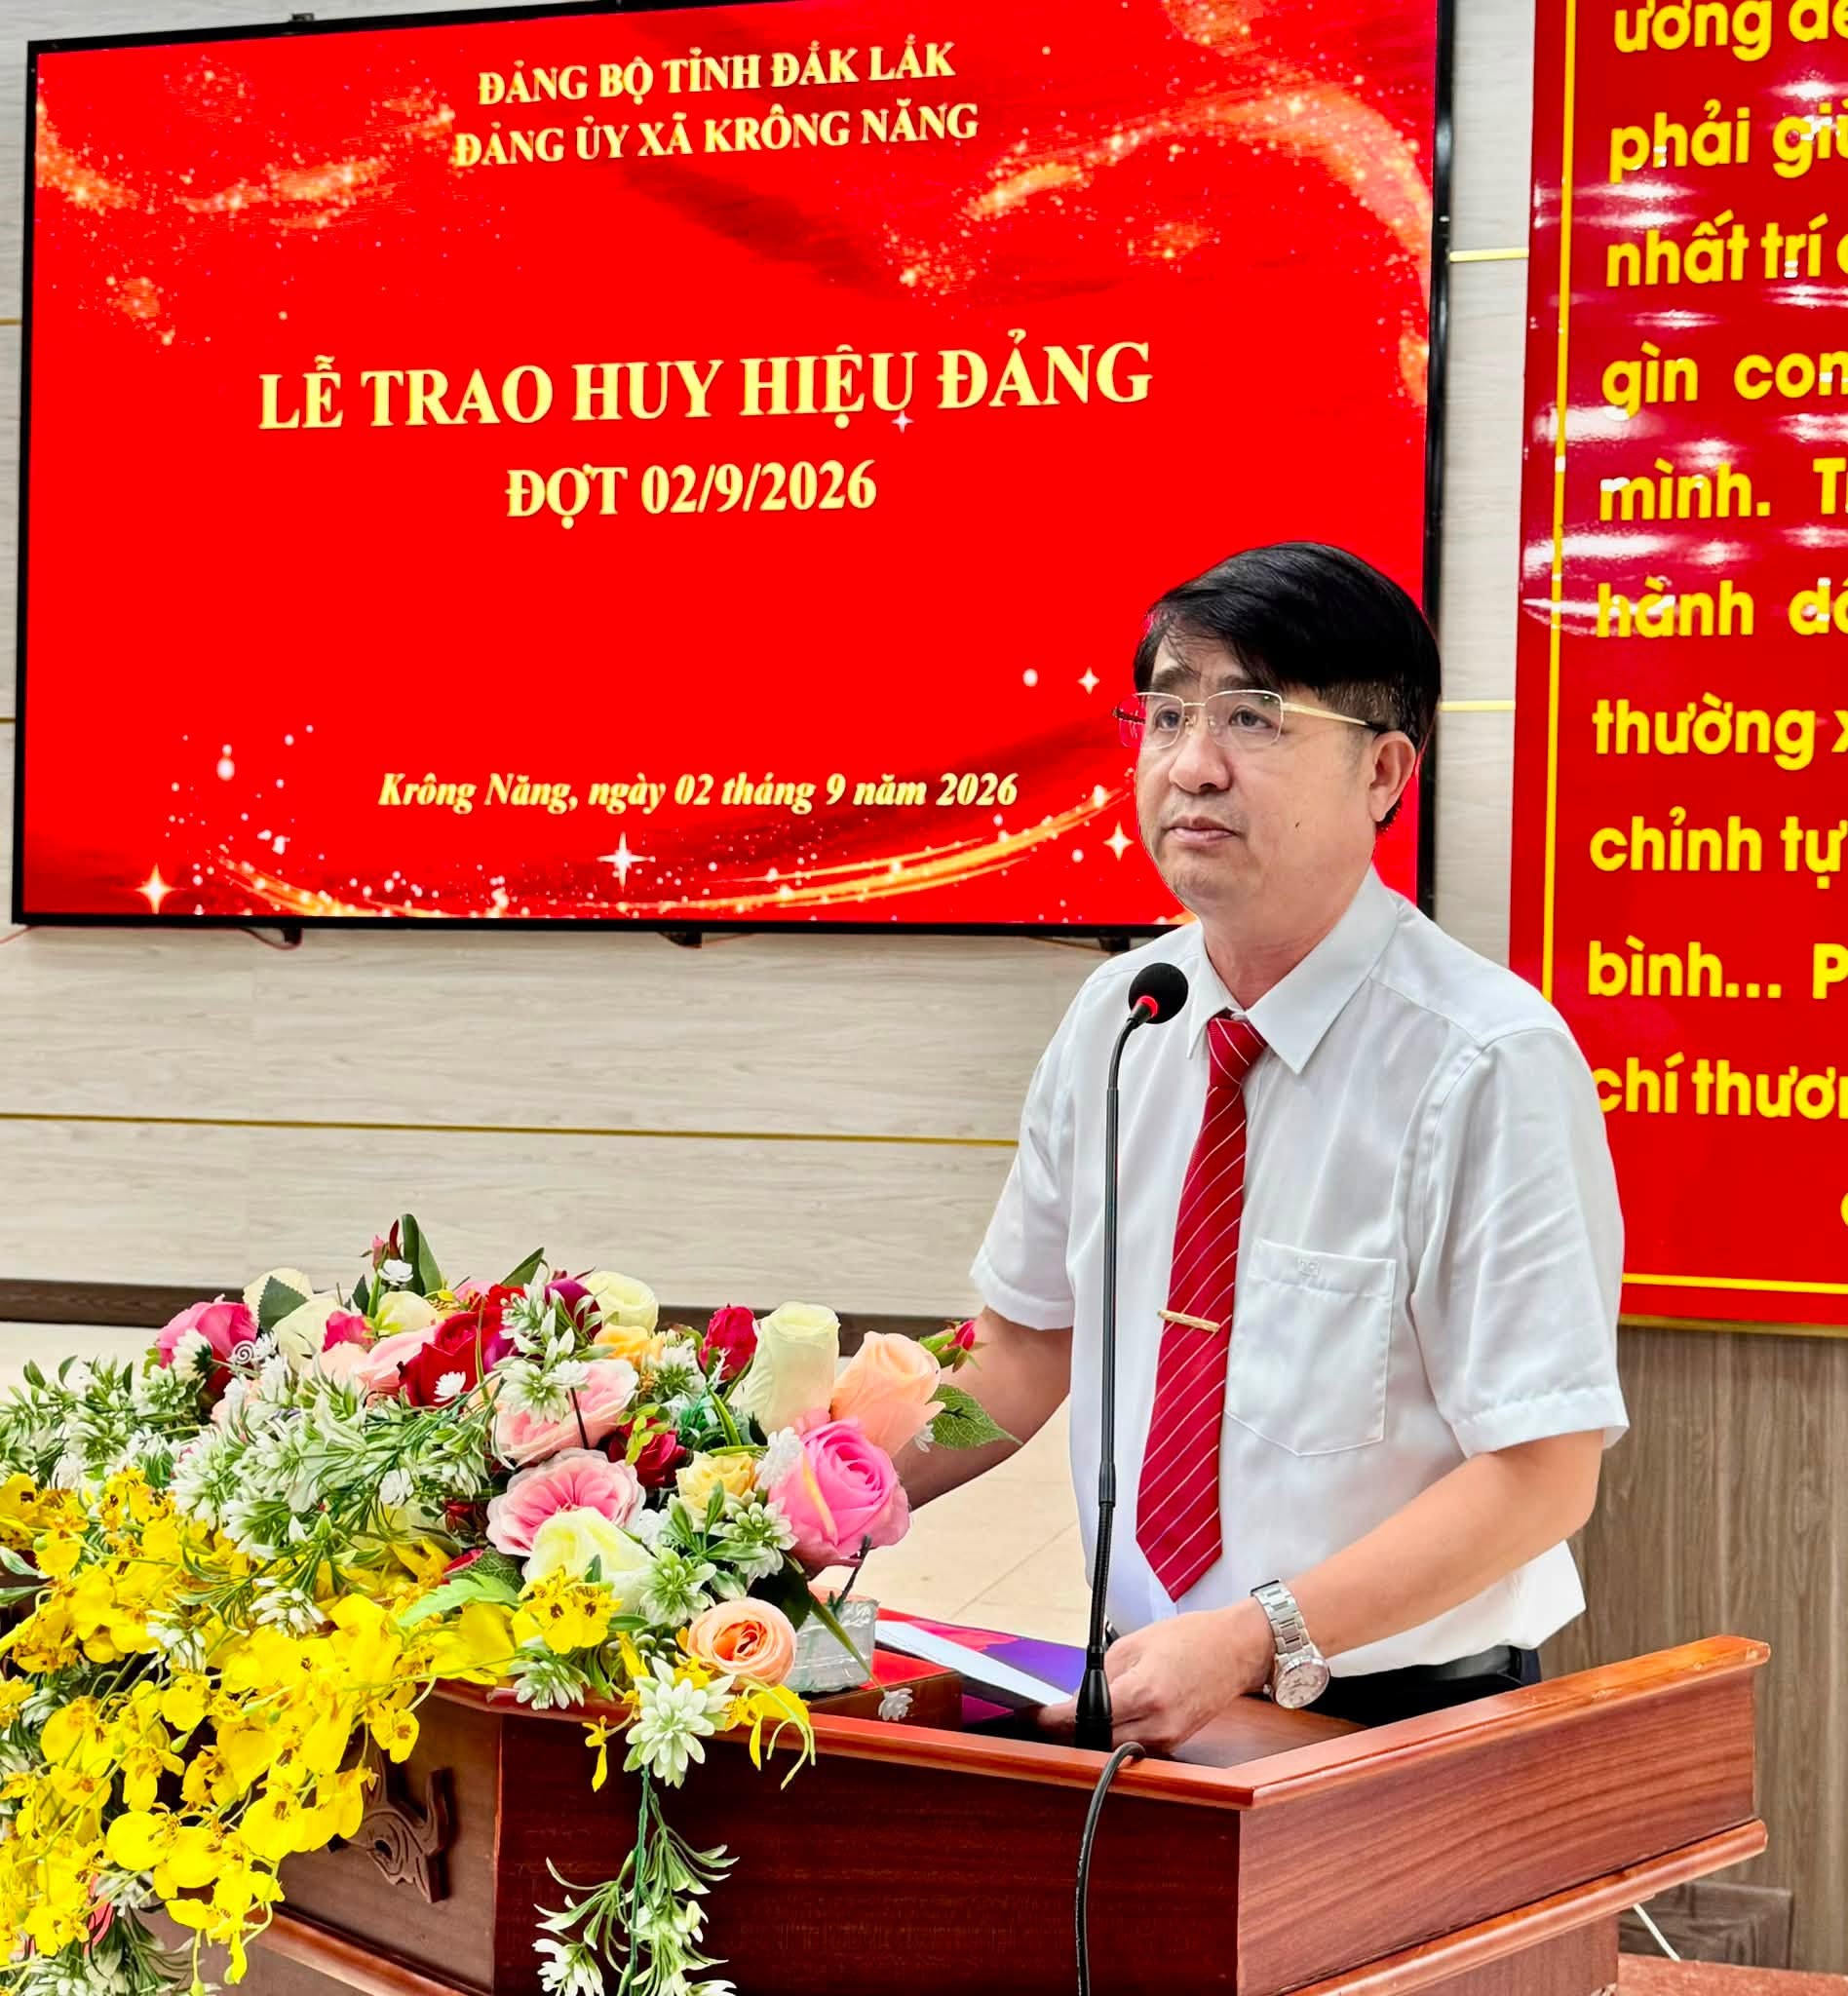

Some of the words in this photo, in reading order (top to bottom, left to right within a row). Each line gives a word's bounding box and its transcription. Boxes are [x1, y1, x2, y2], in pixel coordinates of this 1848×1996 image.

[479, 59, 589, 105] ĐẢNG
[598, 56, 654, 105] BỘ
[661, 46, 761, 94] TỈNH
[770, 40, 860, 88] ĐẮK
[868, 33, 956, 81] LẮK
[453, 121, 564, 167] ĐẢNG
[575, 115, 630, 160] ỦY
[637, 111, 693, 157] XÃ
[704, 102, 851, 153] KRÔNG
[861, 97, 979, 144] NĂNG
[1609, 98, 1751, 185] phải
[1606, 210, 1750, 288] nhất
[1760, 212, 1829, 279] trí
[258, 354, 343, 430] LỄ
[360, 365, 554, 427] TRAO
[571, 359, 724, 421] HUY
[739, 343, 915, 430] HIỆU
[936, 327, 1153, 409] ĐẢNG
[1601, 341, 1699, 422] gìn
[1734, 351, 1848, 400] con
[505, 463, 629, 530] ĐỢT
[640, 459, 877, 515] 02/9/2026
[1599, 457, 1771, 521] mình.
[1813, 457, 1848, 515] T
[1596, 576, 1754, 638] hành
[1592, 692, 1816, 771] thường
[378, 772, 477, 815] Krông
[484, 773, 579, 815] Năng,
[588, 772, 667, 815] ngày
[674, 773, 714, 806] 02
[720, 771, 817, 815] tháng
[826, 773, 846, 805] 9
[852, 773, 928, 806] năm
[935, 772, 1019, 806] 2026
[1590, 806, 1762, 871] chỉnh
[1780, 816, 1848, 890] tự
[1588, 935, 1782, 999] bình...
[1591, 1052, 1685, 1115] chí
[1691, 1058, 1848, 1120] thươ
